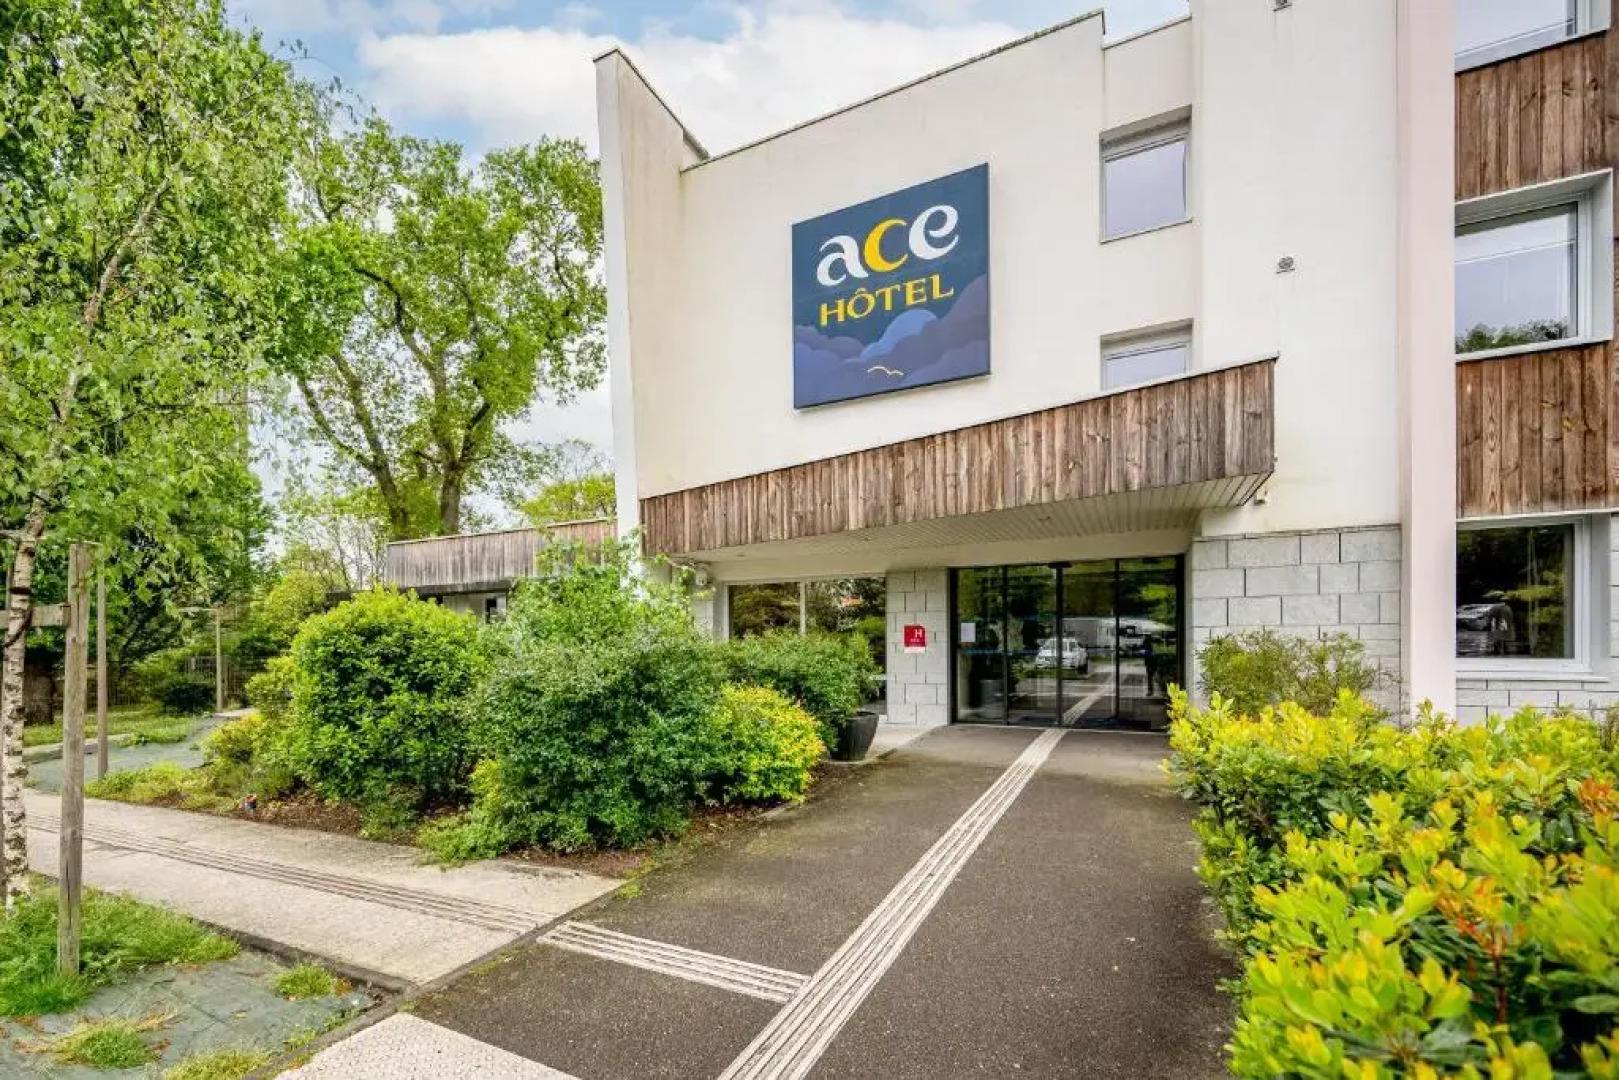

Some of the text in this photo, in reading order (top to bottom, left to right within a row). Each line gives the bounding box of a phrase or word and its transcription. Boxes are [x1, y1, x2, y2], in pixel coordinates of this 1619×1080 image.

[816, 205, 959, 286] ace
[819, 273, 954, 327] HÔTEL
[914, 628, 923, 638] H
